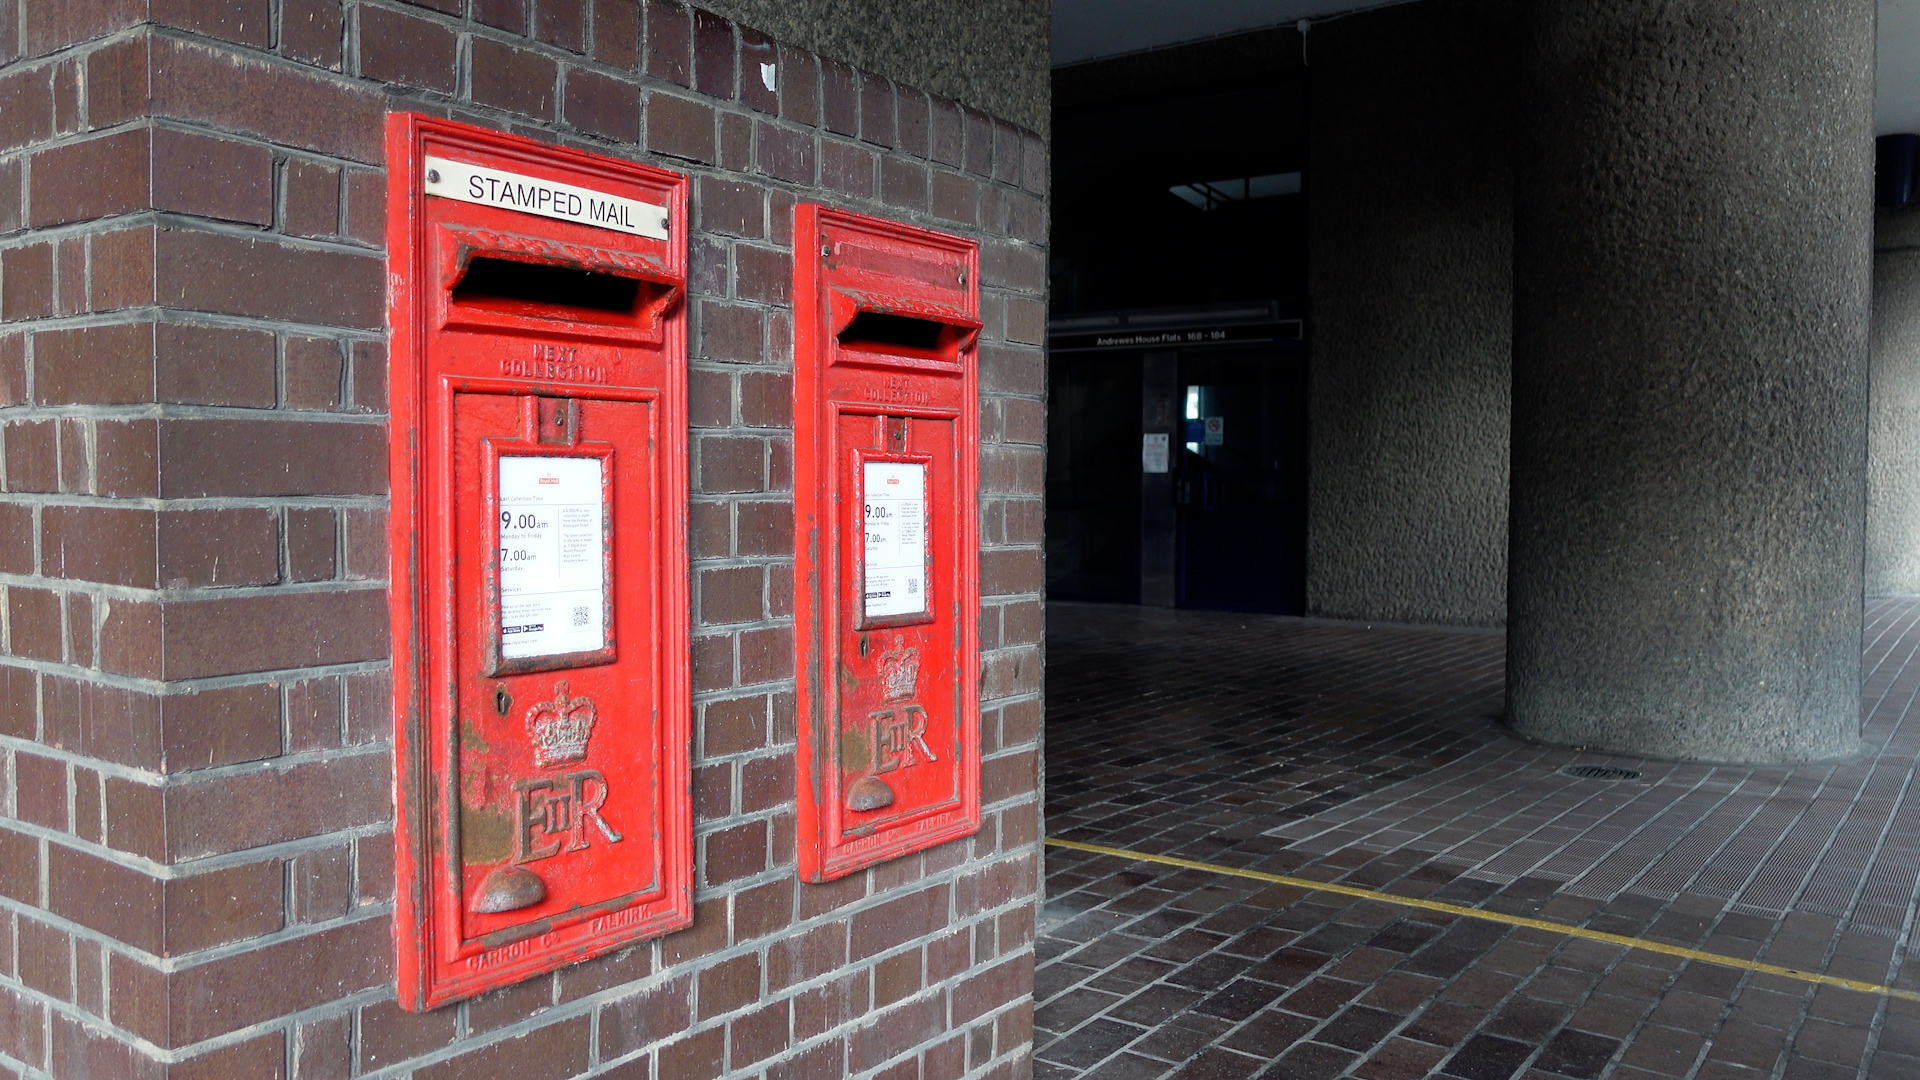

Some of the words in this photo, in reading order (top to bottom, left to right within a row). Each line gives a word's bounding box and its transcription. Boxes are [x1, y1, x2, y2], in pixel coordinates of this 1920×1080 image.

[469, 175, 582, 216] STAMPED
[590, 199, 635, 228] MAIL
[1097, 337, 1134, 346] Andrewes
[1136, 335, 1160, 343] House
[1162, 333, 1181, 342] Flats
[1211, 331, 1225, 339] 184
[533, 344, 577, 362] NEXT
[500, 359, 608, 384] COLLECTION
[501, 511, 548, 529] 9.00am
[501, 548, 537, 561] 7.00am
[466, 939, 531, 970] CARRON
